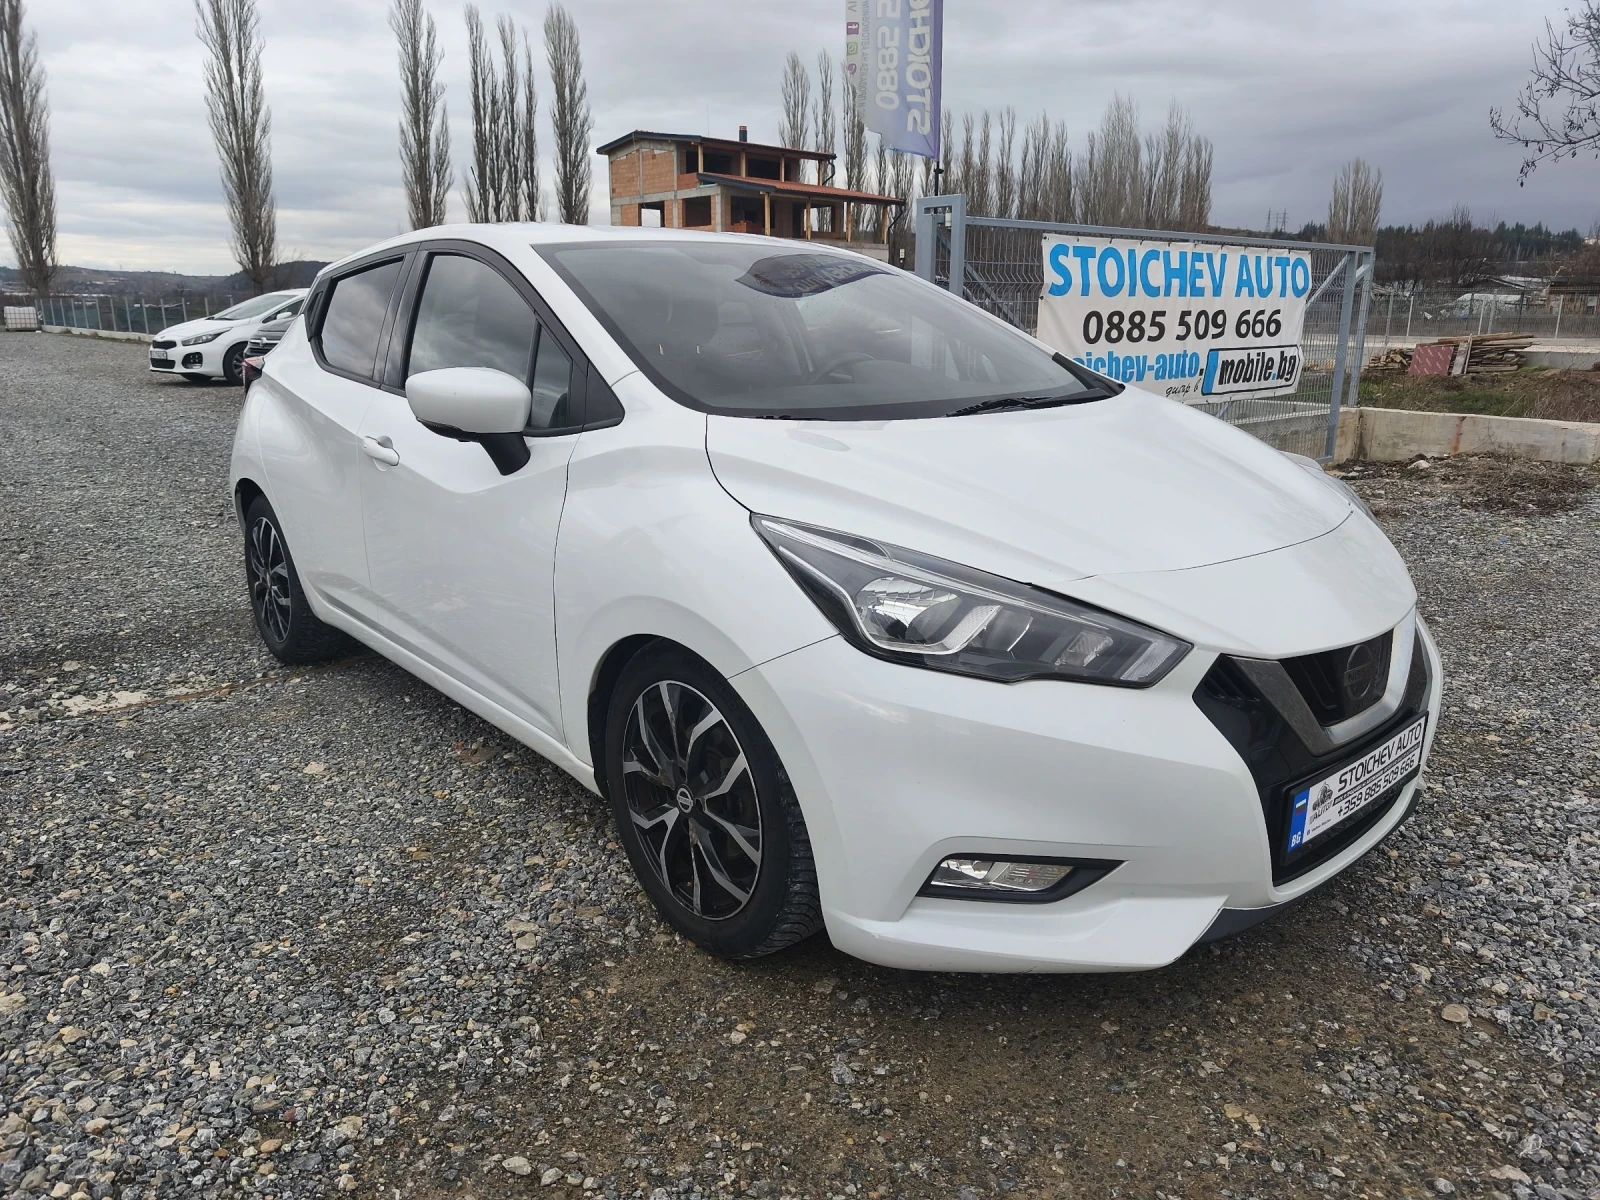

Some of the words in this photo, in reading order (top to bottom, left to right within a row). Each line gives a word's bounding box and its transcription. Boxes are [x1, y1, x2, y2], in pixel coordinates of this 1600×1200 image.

[1048, 244, 1227, 297] STOICHEV
[1235, 254, 1310, 298] AUTO
[1082, 310, 1166, 344] 0885
[1176, 309, 1227, 341] 509
[1235, 309, 1281, 338] 666
[1218, 351, 1296, 385] mobile.bg
[1338, 741, 1395, 792] STOICHEV
[1395, 723, 1421, 755] AUTO
[1338, 792, 1362, 816] +359
[1364, 778, 1382, 801] 885
[1383, 766, 1399, 788] 509
[1400, 754, 1415, 775] 666
[1291, 831, 1302, 848] BG
